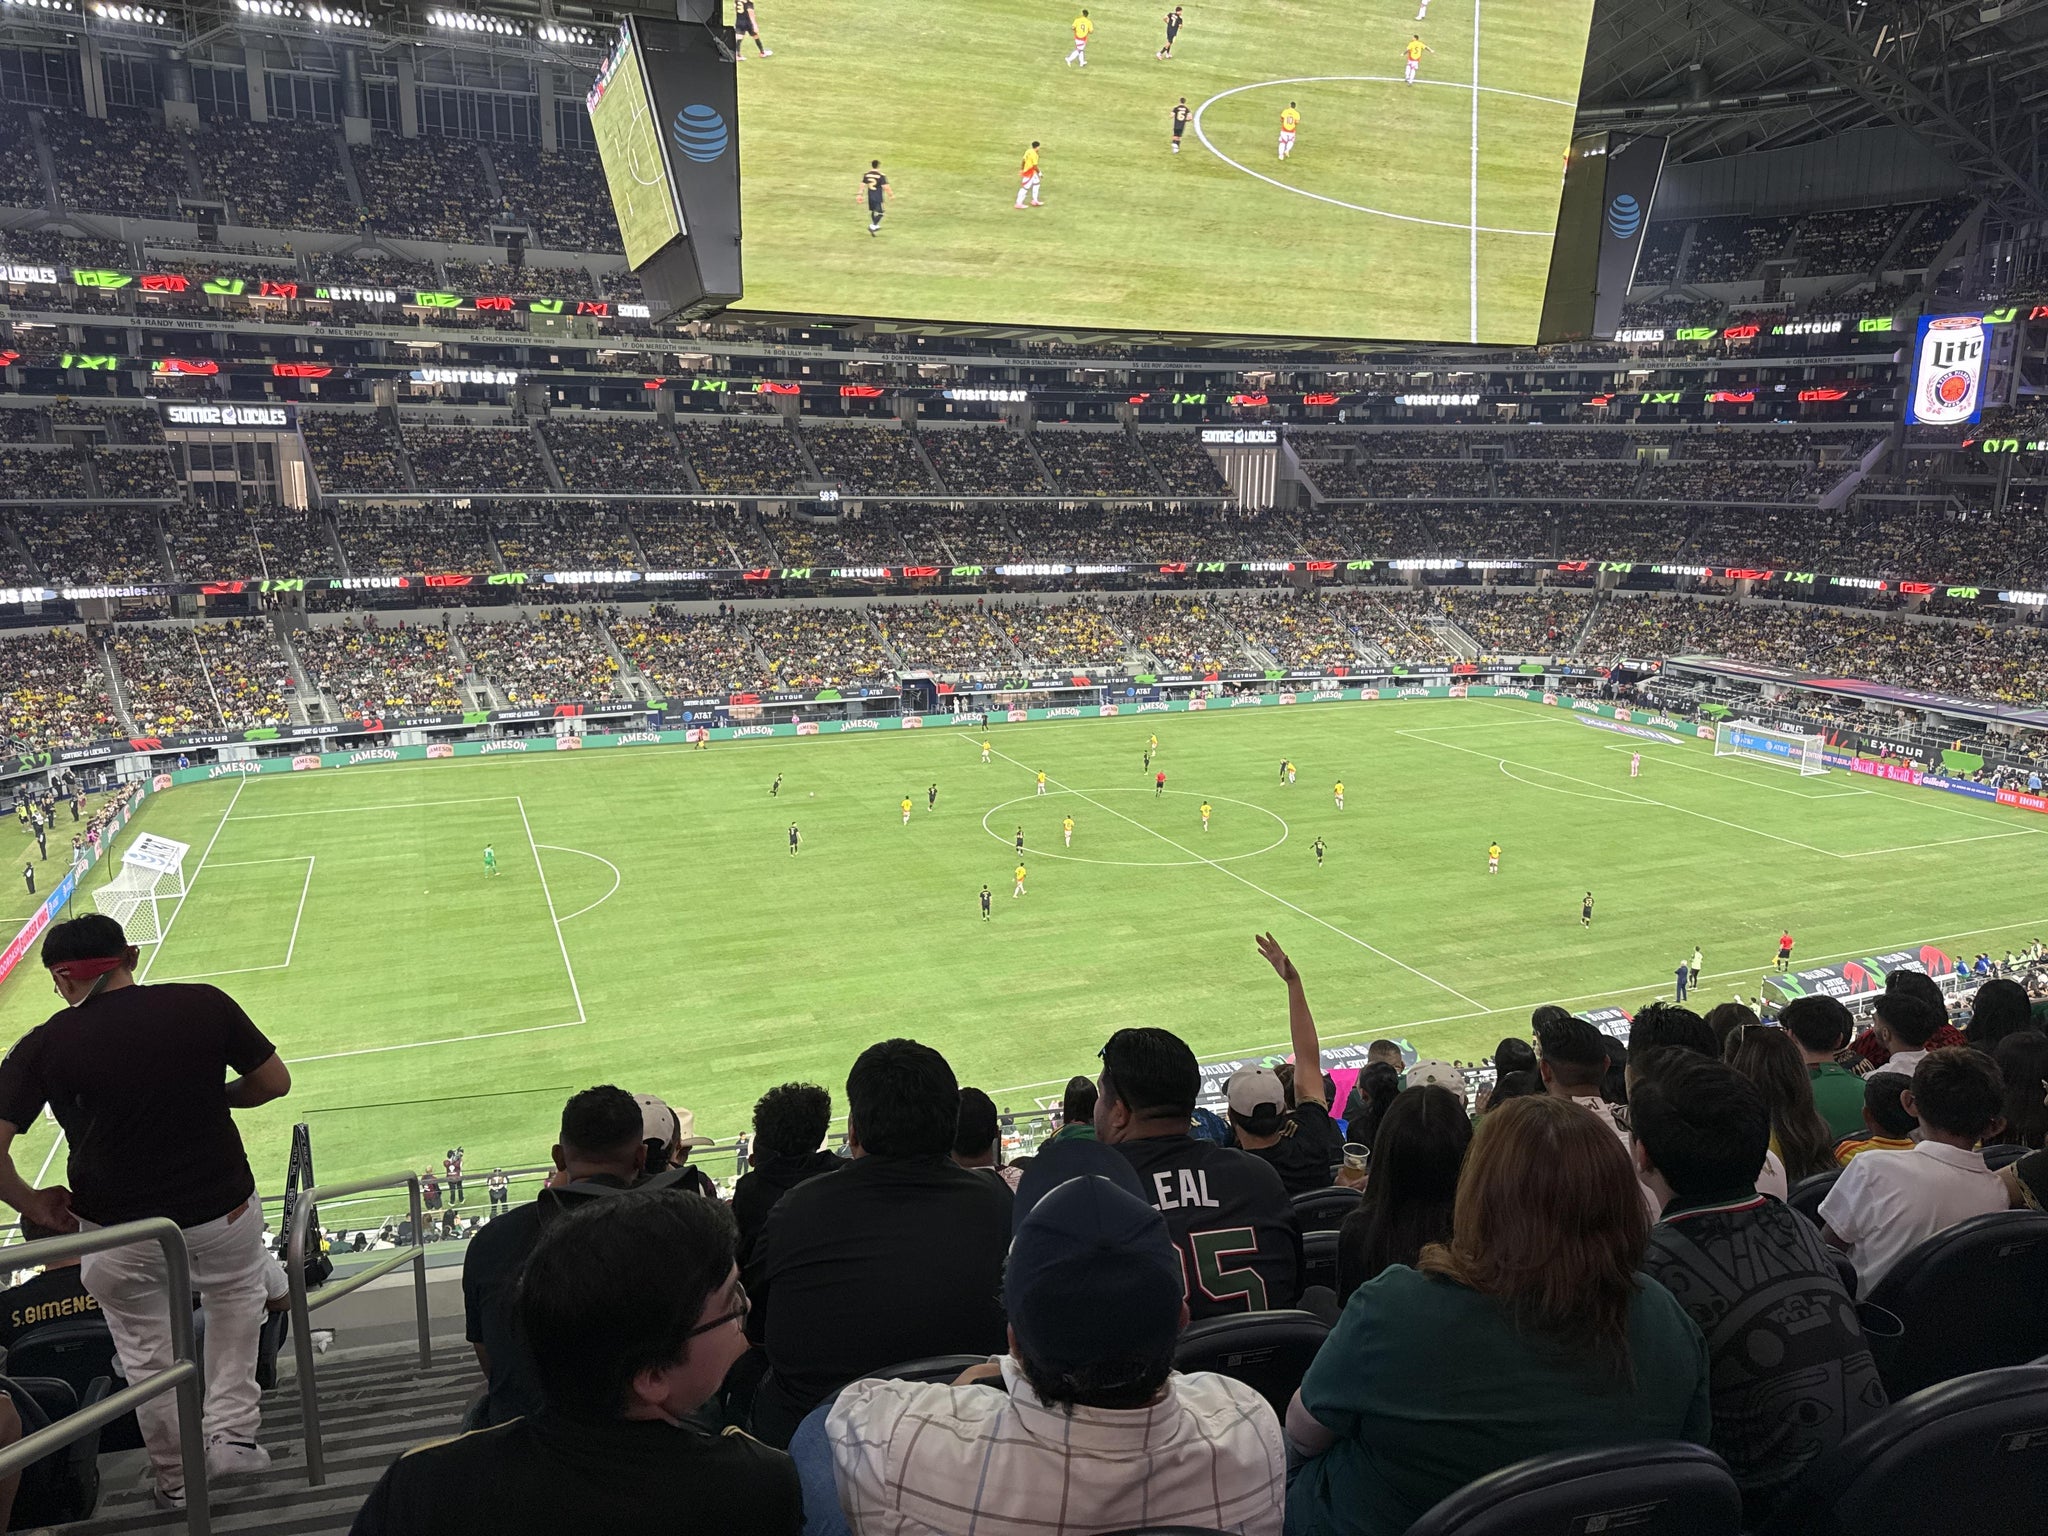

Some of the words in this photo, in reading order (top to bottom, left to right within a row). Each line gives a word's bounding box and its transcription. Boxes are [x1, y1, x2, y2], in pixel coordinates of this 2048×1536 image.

[866, 178, 877, 190] 2
[8, 268, 56, 283] LOCALES
[316, 289, 396, 303] MEXTOUR
[1772, 321, 1842, 335] MEXTOUR
[1631, 329, 1665, 341] LOCALES
[1931, 339, 1982, 369] Lite
[422, 370, 469, 383] VISIT
[471, 370, 495, 383] US
[496, 372, 519, 385] AT
[952, 388, 988, 401] VISIT
[989, 389, 1009, 401] US
[1010, 390, 1028, 402] AT
[1404, 395, 1440, 406] VISIT
[1441, 395, 1460, 405] US
[1462, 395, 1479, 405] AT
[236, 409, 286, 426] LOCALES
[1245, 430, 1276, 443] LOCALES
[1004, 565, 1034, 576] VISIT
[1050, 565, 1066, 575] AT
[1241, 562, 1290, 571] MEXTOUR
[1397, 559, 1425, 570] VISIT
[1651, 565, 1705, 575] MEXTOUR
[555, 572, 594, 583] VISIT
[614, 571, 631, 582] AT
[831, 568, 885, 578] MEXTOUR
[330, 578, 400, 589] MEXTOUR
[1830, 577, 1881, 589] MEXTOUR
[22, 588, 44, 601] AT
[2009, 591, 2047, 605] VISIT
[868, 688, 884, 696] AT&T
[1312, 690, 1343, 702] JAMESON
[1397, 688, 1429, 698] JAMESON
[1494, 687, 1529, 699] JAMESON
[594, 704, 632, 712] MEXTOUR
[1137, 702, 1169, 713] JAMESON
[1231, 695, 1262, 708] JAMESON
[1572, 700, 1599, 714] JAMESON
[694, 711, 712, 720] AT&T
[1046, 707, 1080, 719] JAMESON
[399, 717, 442, 727] MEXTOUR
[840, 719, 879, 732] JAMESON
[1647, 716, 1678, 731] JAMESON
[617, 732, 661, 745] JAMESON
[732, 725, 775, 739] JAMESON
[179, 735, 228, 745] MEXTOUR
[480, 739, 528, 754] JAMESON
[1773, 744, 1788, 752] AT&T
[1859, 738, 1924, 758] MEXTOUR
[349, 750, 398, 764] JAMESON
[209, 762, 262, 778] JAMESON
[1922, 776, 1949, 790] Gillette
[2000, 793, 2017, 803] THE
[2020, 797, 2045, 808] HOME
[1151, 1168, 1219, 1211] EAL
[1172, 1225, 1268, 1313] 5
[11, 1294, 103, 1328] S.GIMENE
